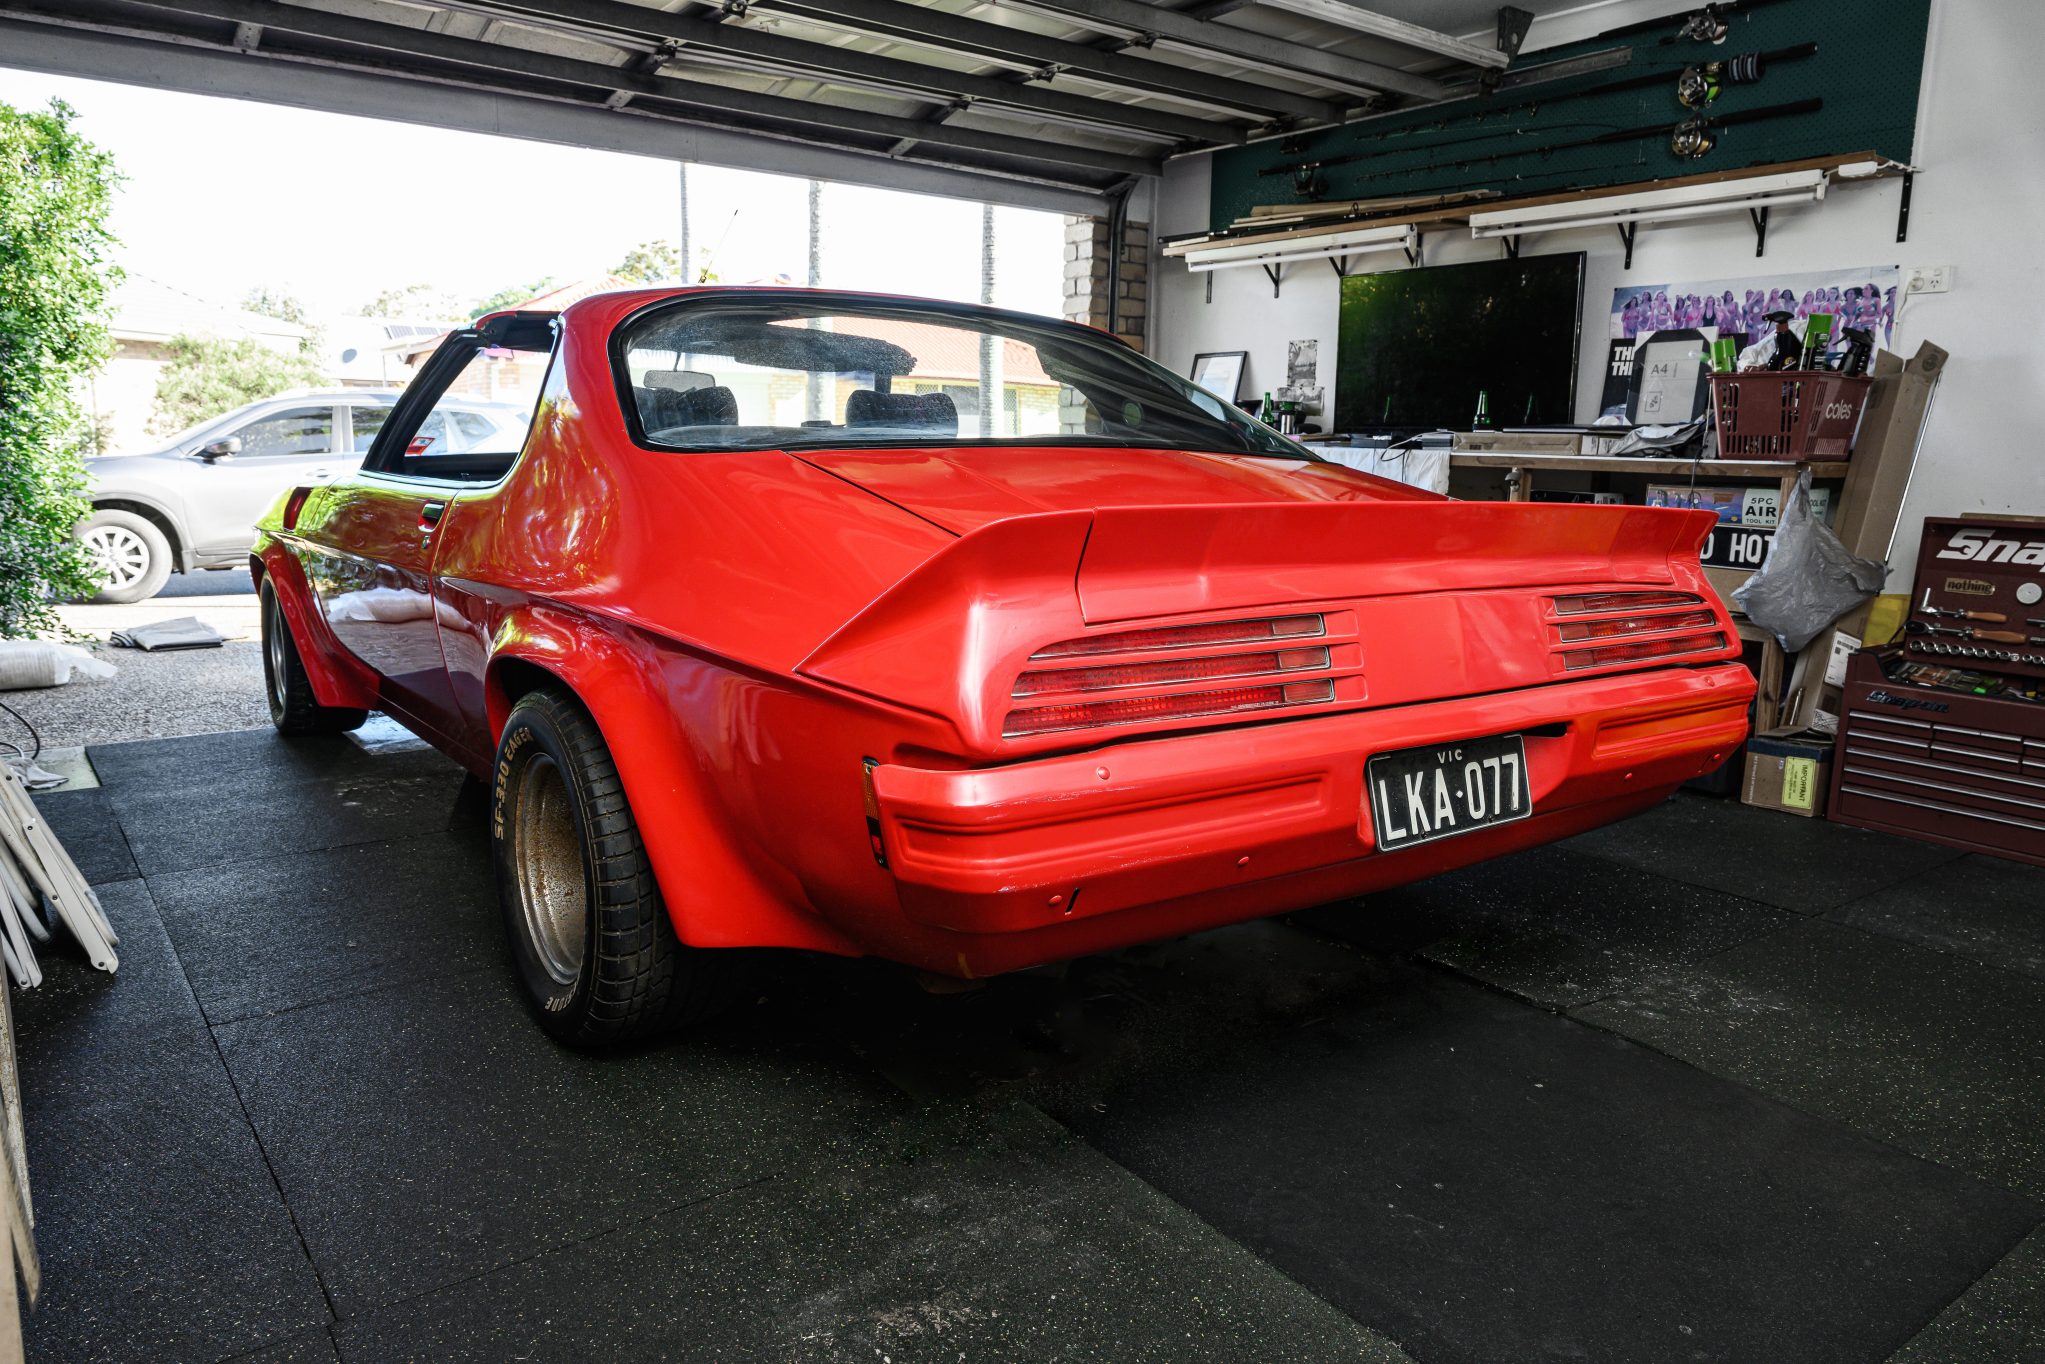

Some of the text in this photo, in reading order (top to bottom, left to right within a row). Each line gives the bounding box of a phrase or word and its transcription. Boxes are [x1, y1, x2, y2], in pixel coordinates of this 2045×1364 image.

[1650, 363, 1669, 375] A4
[1825, 400, 1853, 420] coles
[1750, 497, 1774, 505] 5PC
[1745, 505, 1777, 518] AIR
[1936, 528, 2045, 573] Sna
[1947, 580, 1992, 594] nothing
[1437, 748, 1463, 764] VIC
[1798, 764, 1809, 802] IMPORTANT
